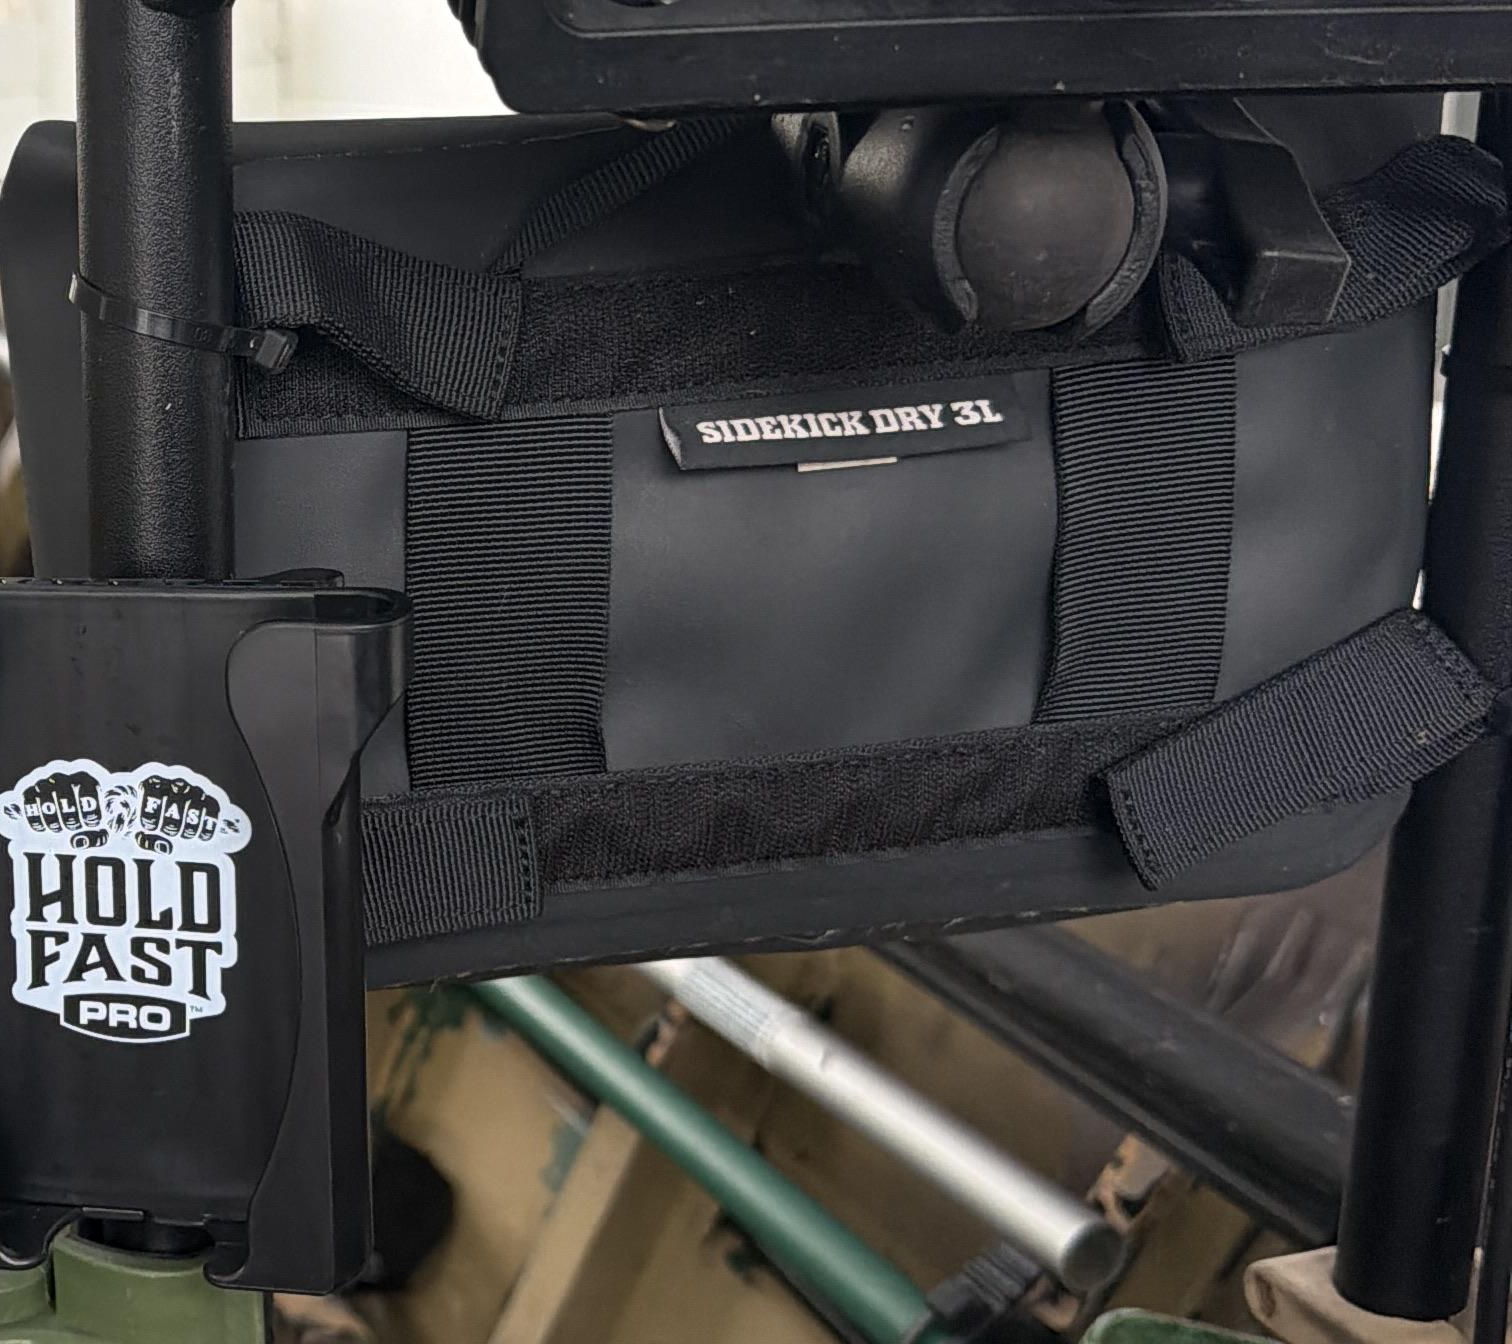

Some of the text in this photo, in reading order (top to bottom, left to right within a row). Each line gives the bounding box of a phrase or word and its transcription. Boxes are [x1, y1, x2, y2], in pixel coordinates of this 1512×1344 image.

[695, 398, 1004, 444] SIDEKICK DRY 3L
[24, 796, 218, 833] HOLD FAST
[23, 852, 221, 934] HOLD
[26, 929, 222, 1000] FAST
[80, 1000, 171, 1032] PRO
